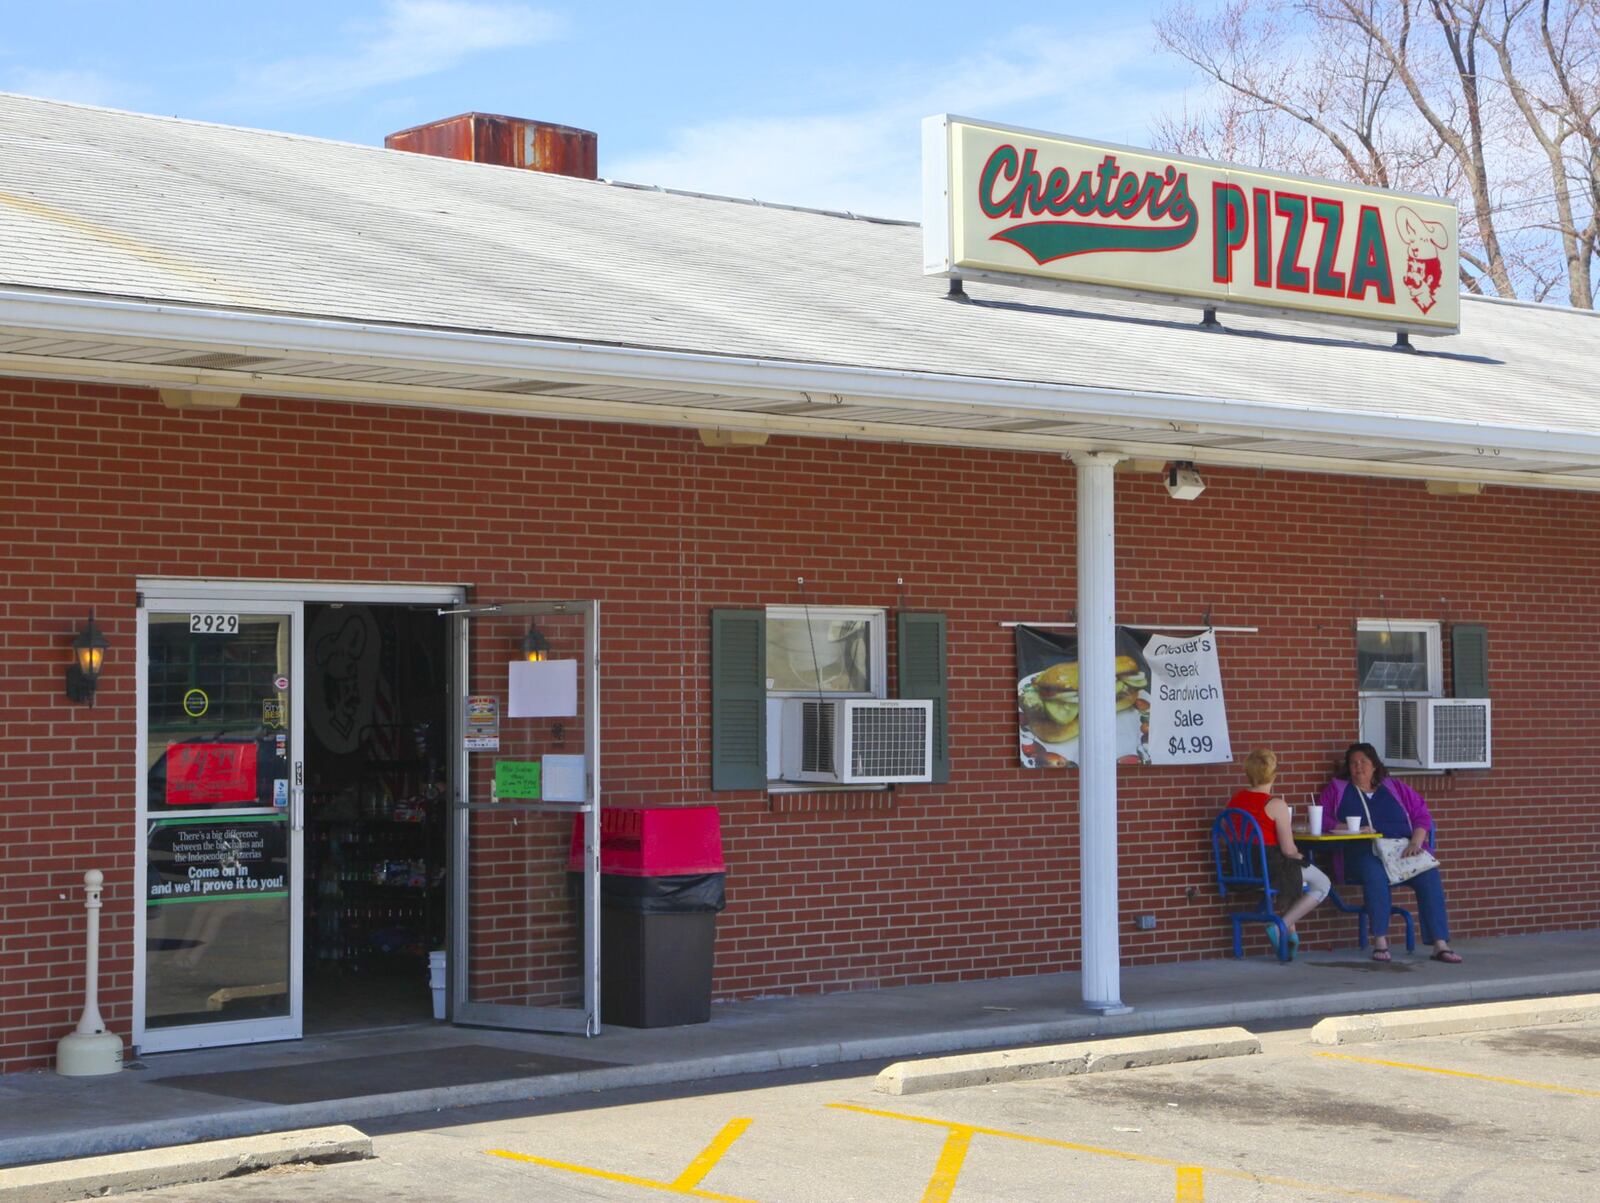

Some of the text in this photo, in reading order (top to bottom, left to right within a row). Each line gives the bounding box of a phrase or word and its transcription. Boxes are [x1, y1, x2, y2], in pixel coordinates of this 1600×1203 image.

[978, 143, 1397, 305] Chester's PIZZA
[191, 614, 237, 632] 2929
[1159, 684, 1219, 701] Sandwich
[1174, 709, 1204, 727] Sale
[1167, 735, 1213, 755] $4.99
[178, 829, 259, 841] There's a big difference
[172, 842, 202, 852] between
[203, 841, 215, 851] the
[251, 839, 264, 849] and
[175, 853, 187, 863] the
[188, 850, 231, 863] Independent
[187, 865, 249, 879] Come on in
[151, 875, 283, 895] and we'll prove it to you!
